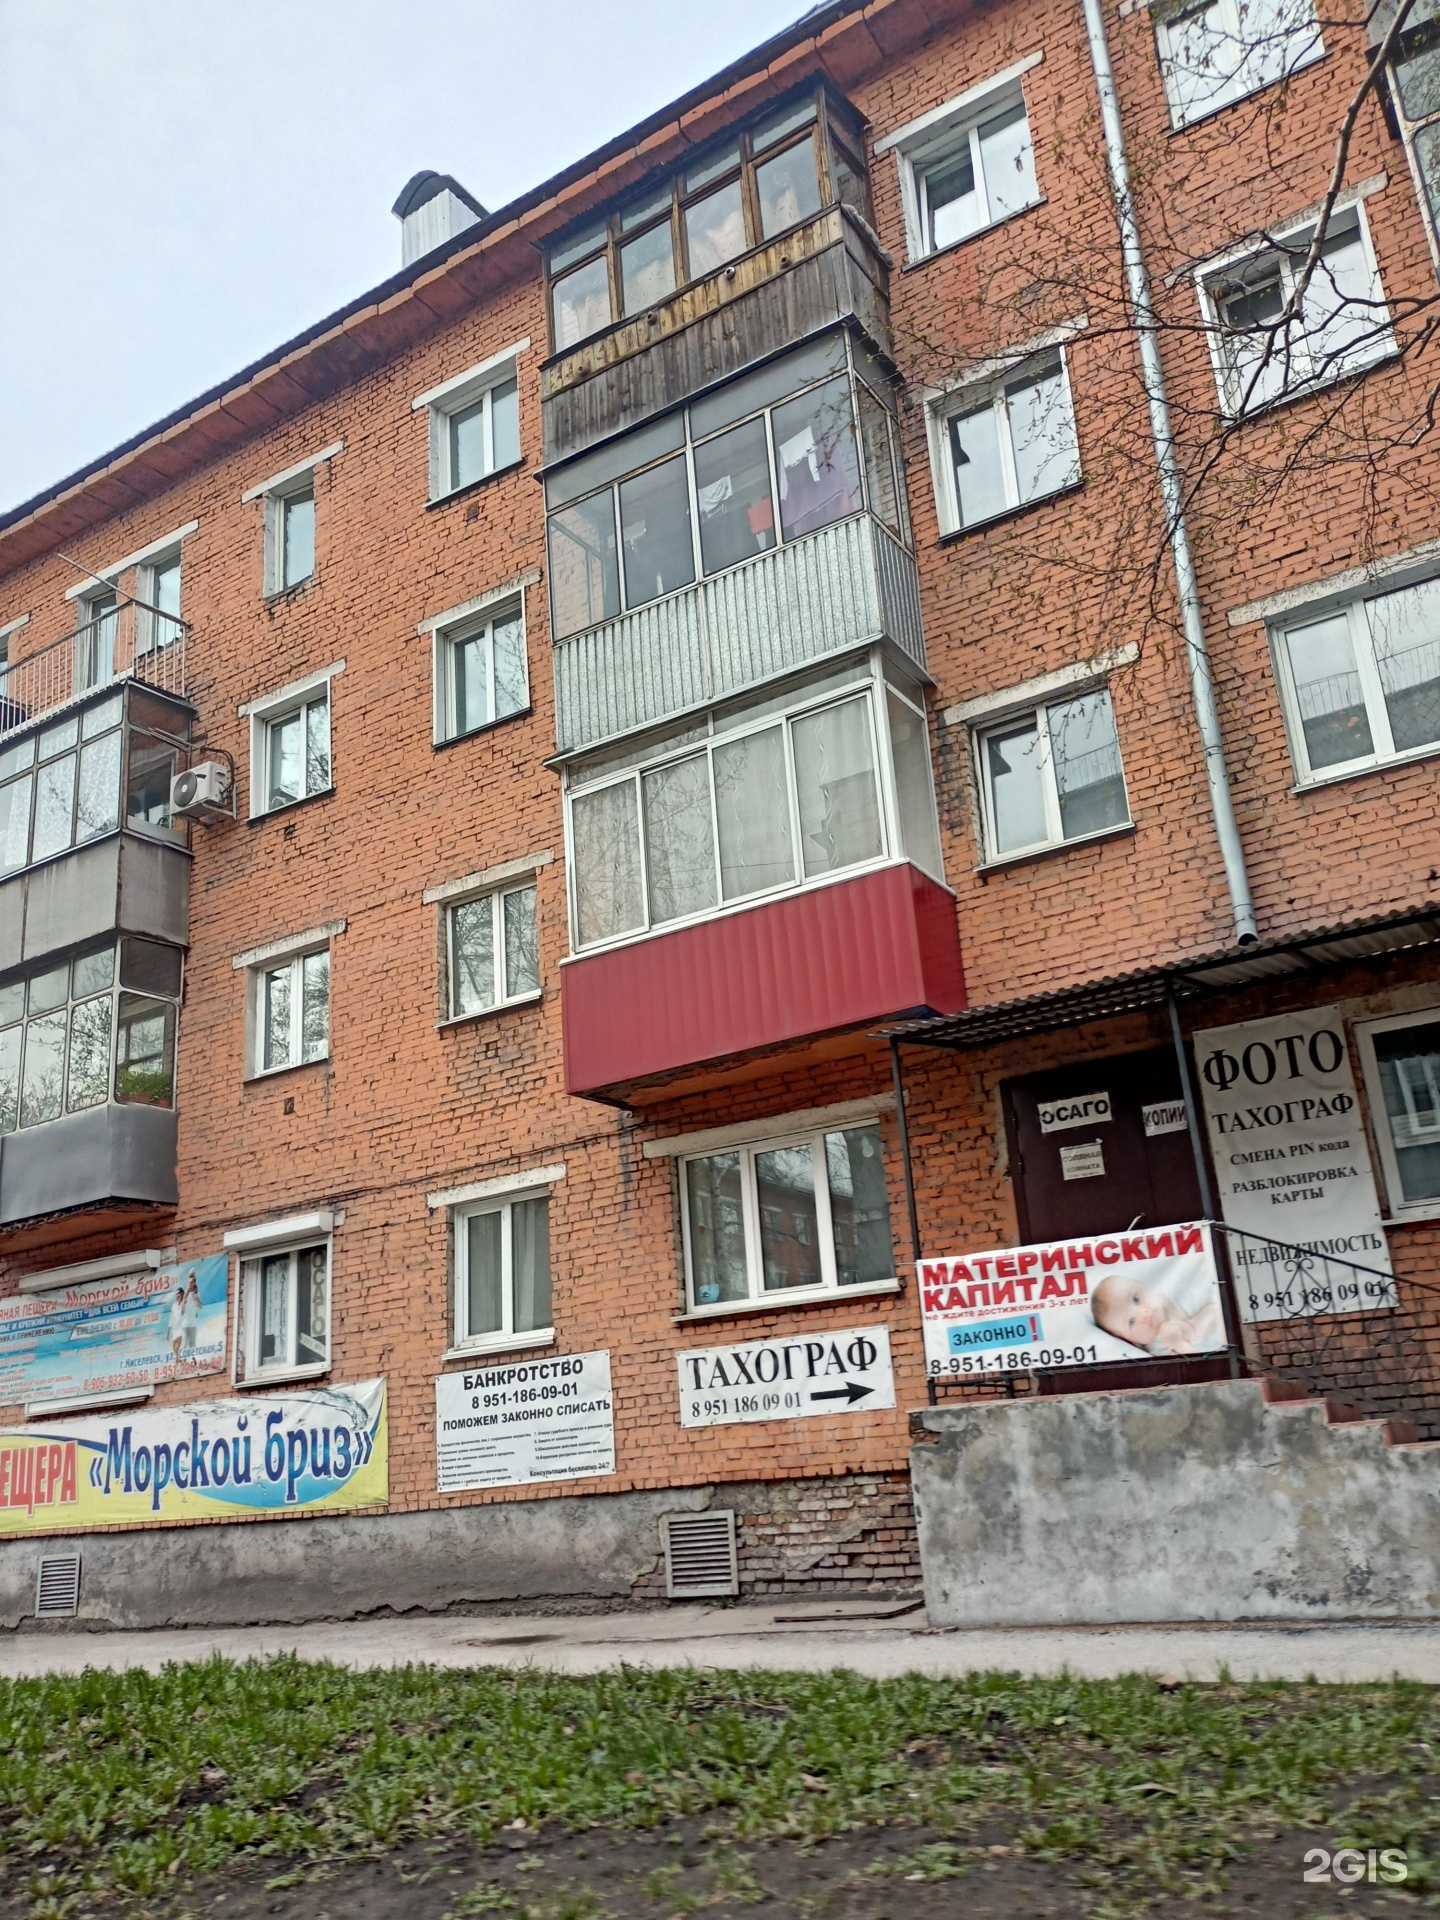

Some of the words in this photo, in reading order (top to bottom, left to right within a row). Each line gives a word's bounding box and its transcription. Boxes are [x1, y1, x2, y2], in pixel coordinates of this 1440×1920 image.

[1203, 1029, 1344, 1092] ФОТО
[1041, 1100, 1109, 1125] ОСАГО
[1212, 1093, 1353, 1134] ТАХОГРАФ
[1230, 1148, 1286, 1165] СМЕНА
[1288, 1142, 1315, 1157] PIN
[1318, 1140, 1350, 1152] кода
[1232, 1166, 1358, 1193] РАЗБЛОКИРОВКА
[1271, 1187, 1324, 1204] КАРТЫ
[921, 1224, 1204, 1287] МАТЕРИНСКИЙ
[1235, 1233, 1382, 1266] НЕДВИЖИМОСТЬ
[922, 1271, 1088, 1313] КАПИТАЛ
[1249, 1295, 1259, 1310] 8
[1264, 1291, 1294, 1308] 951
[1300, 1286, 1332, 1304] 186
[1338, 1283, 1358, 1301] 09
[464, 1359, 583, 1390] БАНКРОТСТВО
[686, 1336, 877, 1390] ТАХОГРАФ
[930, 1345, 1098, 1375] 8-951-186-09-01
[472, 1396, 479, 1409] 8
[484, 1382, 578, 1407] 951-186-09-01
[692, 1401, 700, 1418] 8
[704, 1398, 728, 1416] 951
[735, 1393, 758, 1413] 186
[763, 1392, 780, 1410] 09
[785, 1391, 801, 1408] 01
[443, 1415, 498, 1431] ПОМОЖЕМ
[502, 1408, 553, 1423] ЗАКОННО
[557, 1400, 610, 1416] СПИСАТЬ
[89, 1412, 252, 1511] «Морской
[264, 1408, 373, 1501] бриз»
